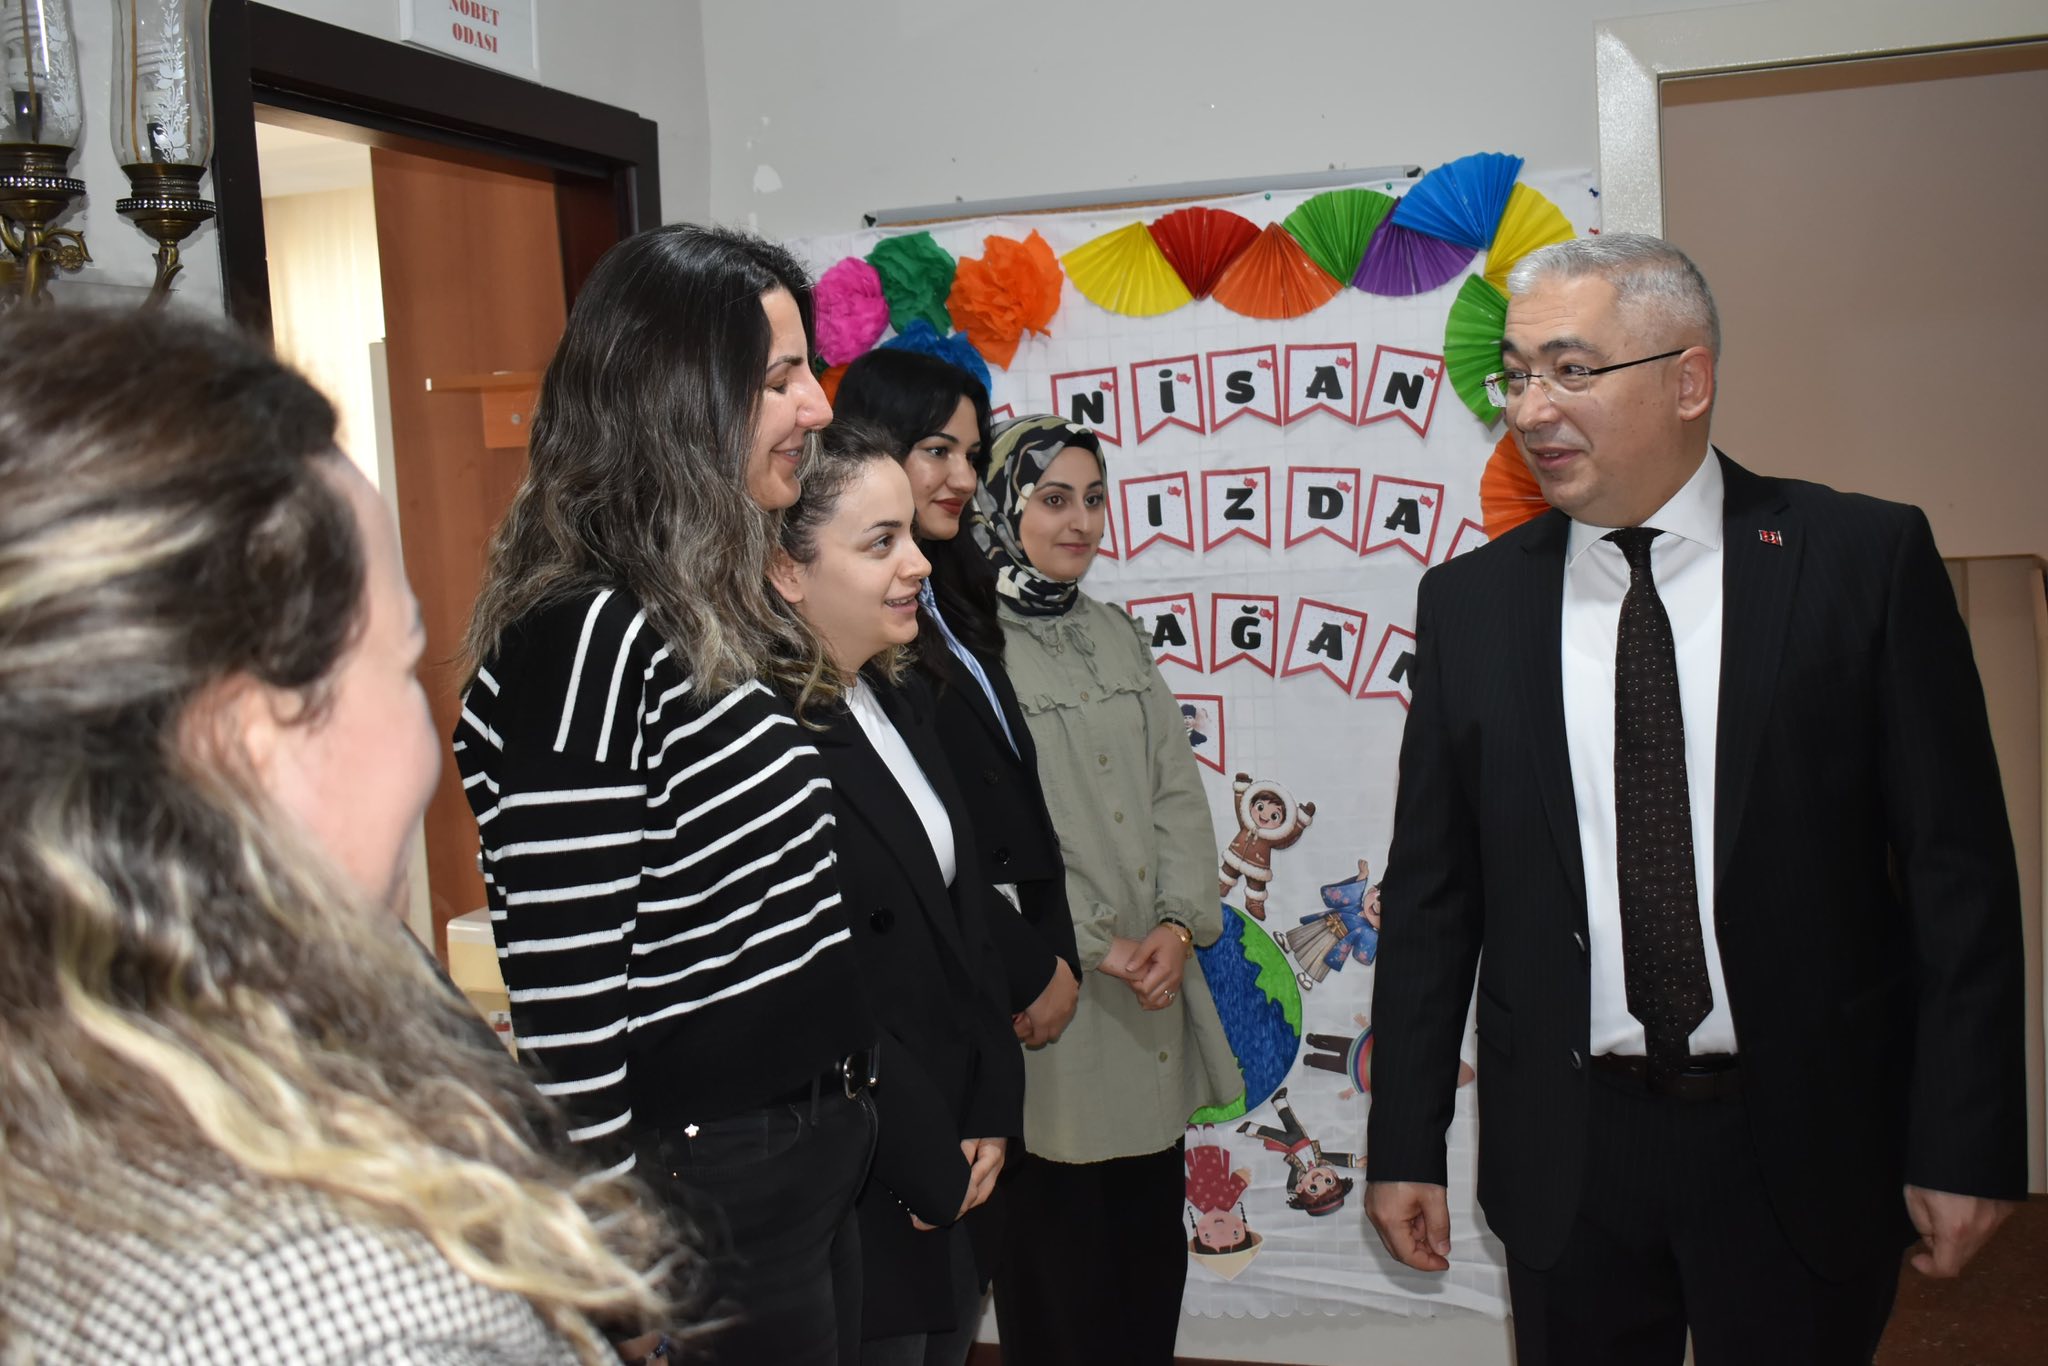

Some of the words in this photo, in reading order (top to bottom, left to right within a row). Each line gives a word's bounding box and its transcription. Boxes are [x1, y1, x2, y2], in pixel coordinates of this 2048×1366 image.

[452, 22, 498, 53] ODASI
[1071, 366, 1425, 424] NİSAN
[1147, 487, 1421, 535] IZDA
